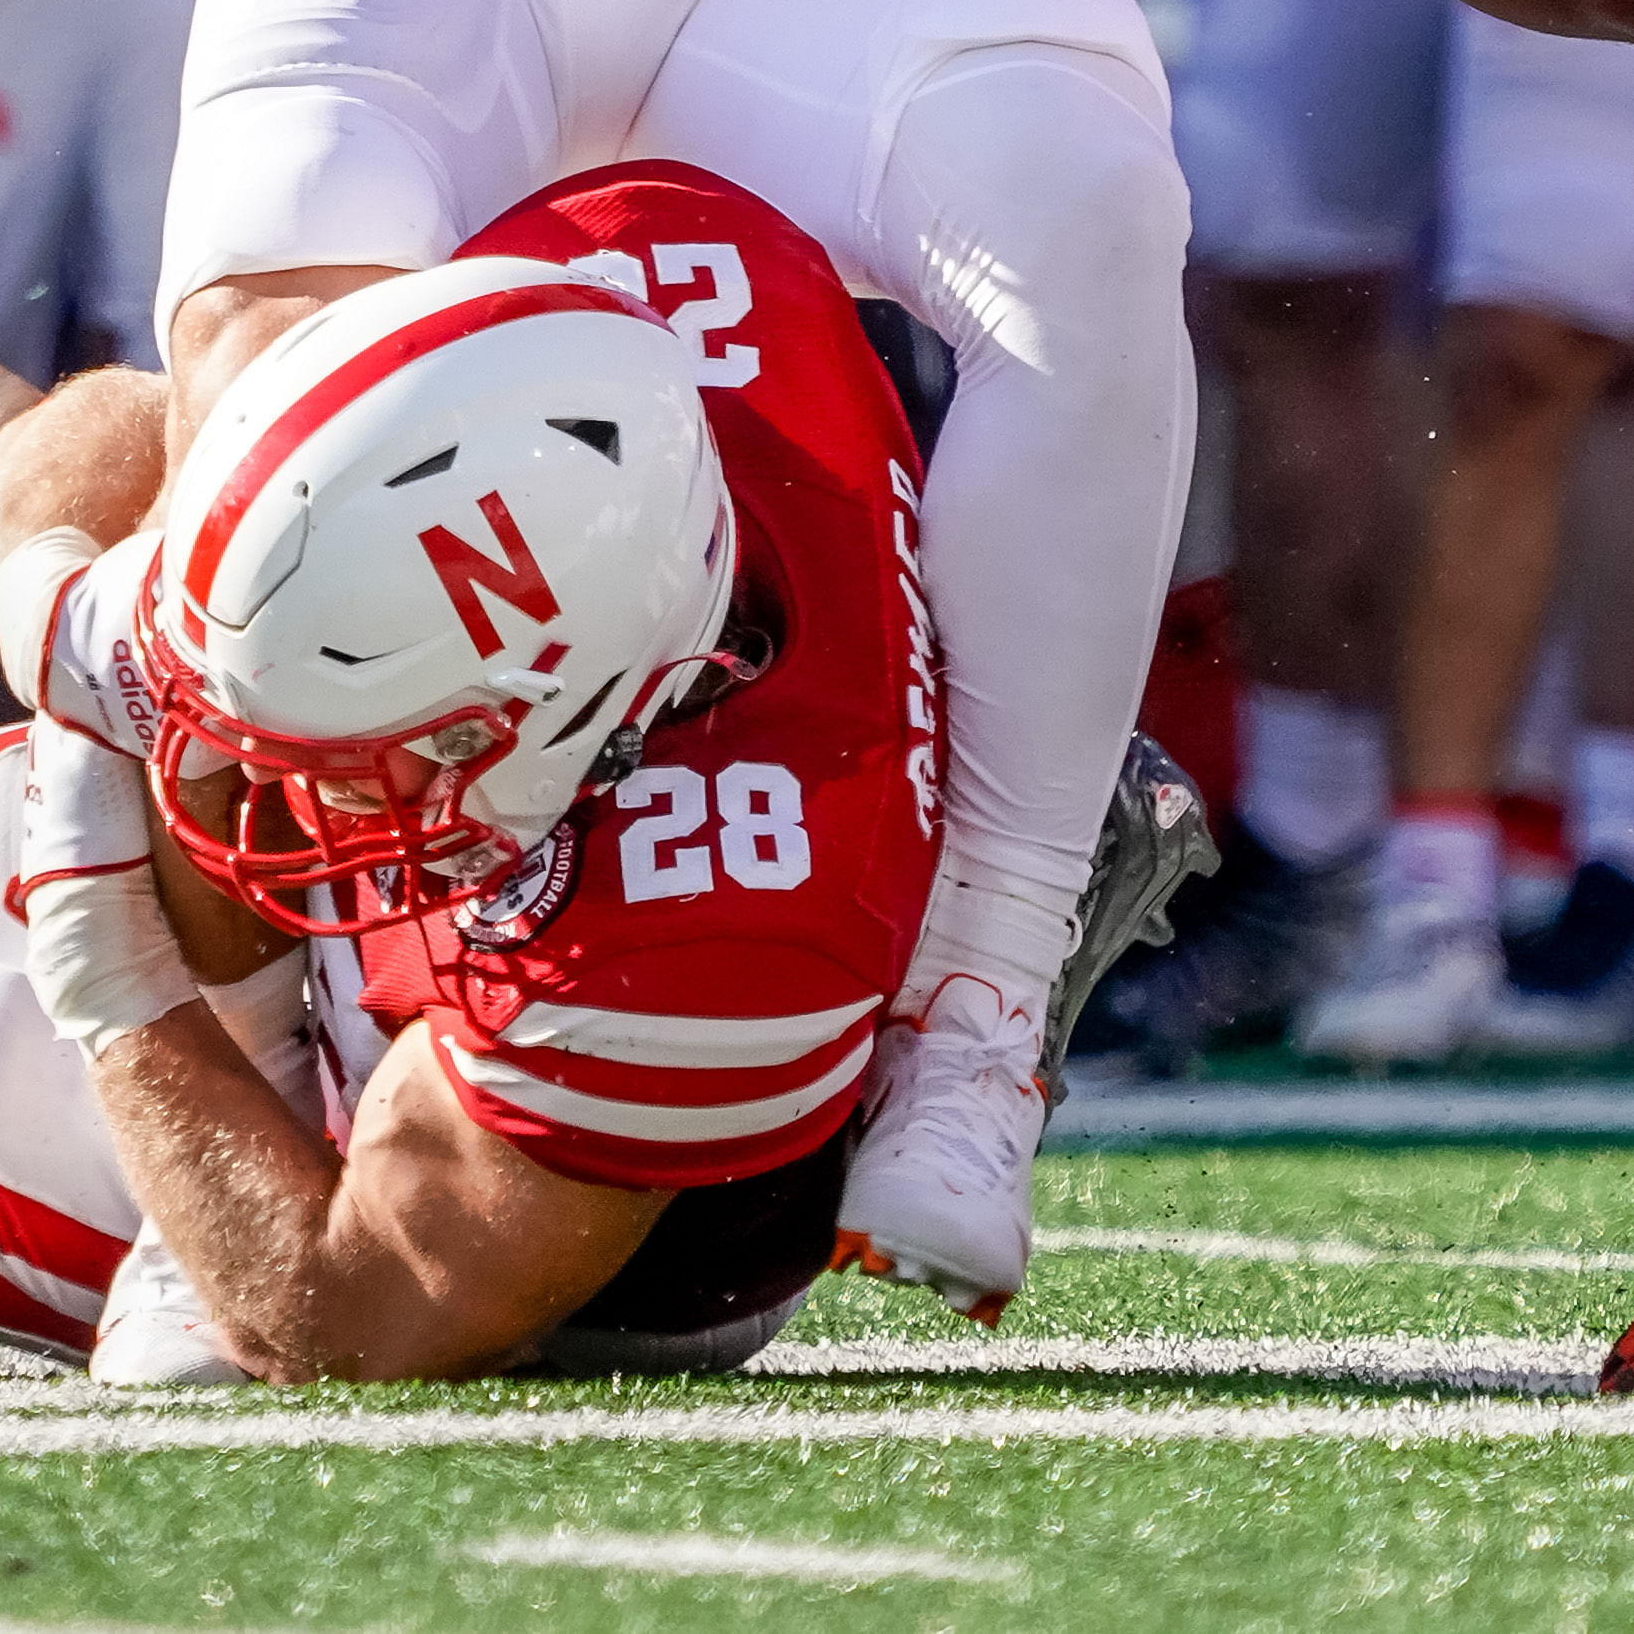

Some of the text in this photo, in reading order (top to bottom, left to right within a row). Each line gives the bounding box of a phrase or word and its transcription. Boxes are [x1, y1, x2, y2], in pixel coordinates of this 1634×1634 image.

[566, 242, 761, 388] 2
[417, 489, 562, 661] N
[615, 759, 813, 904] 28
